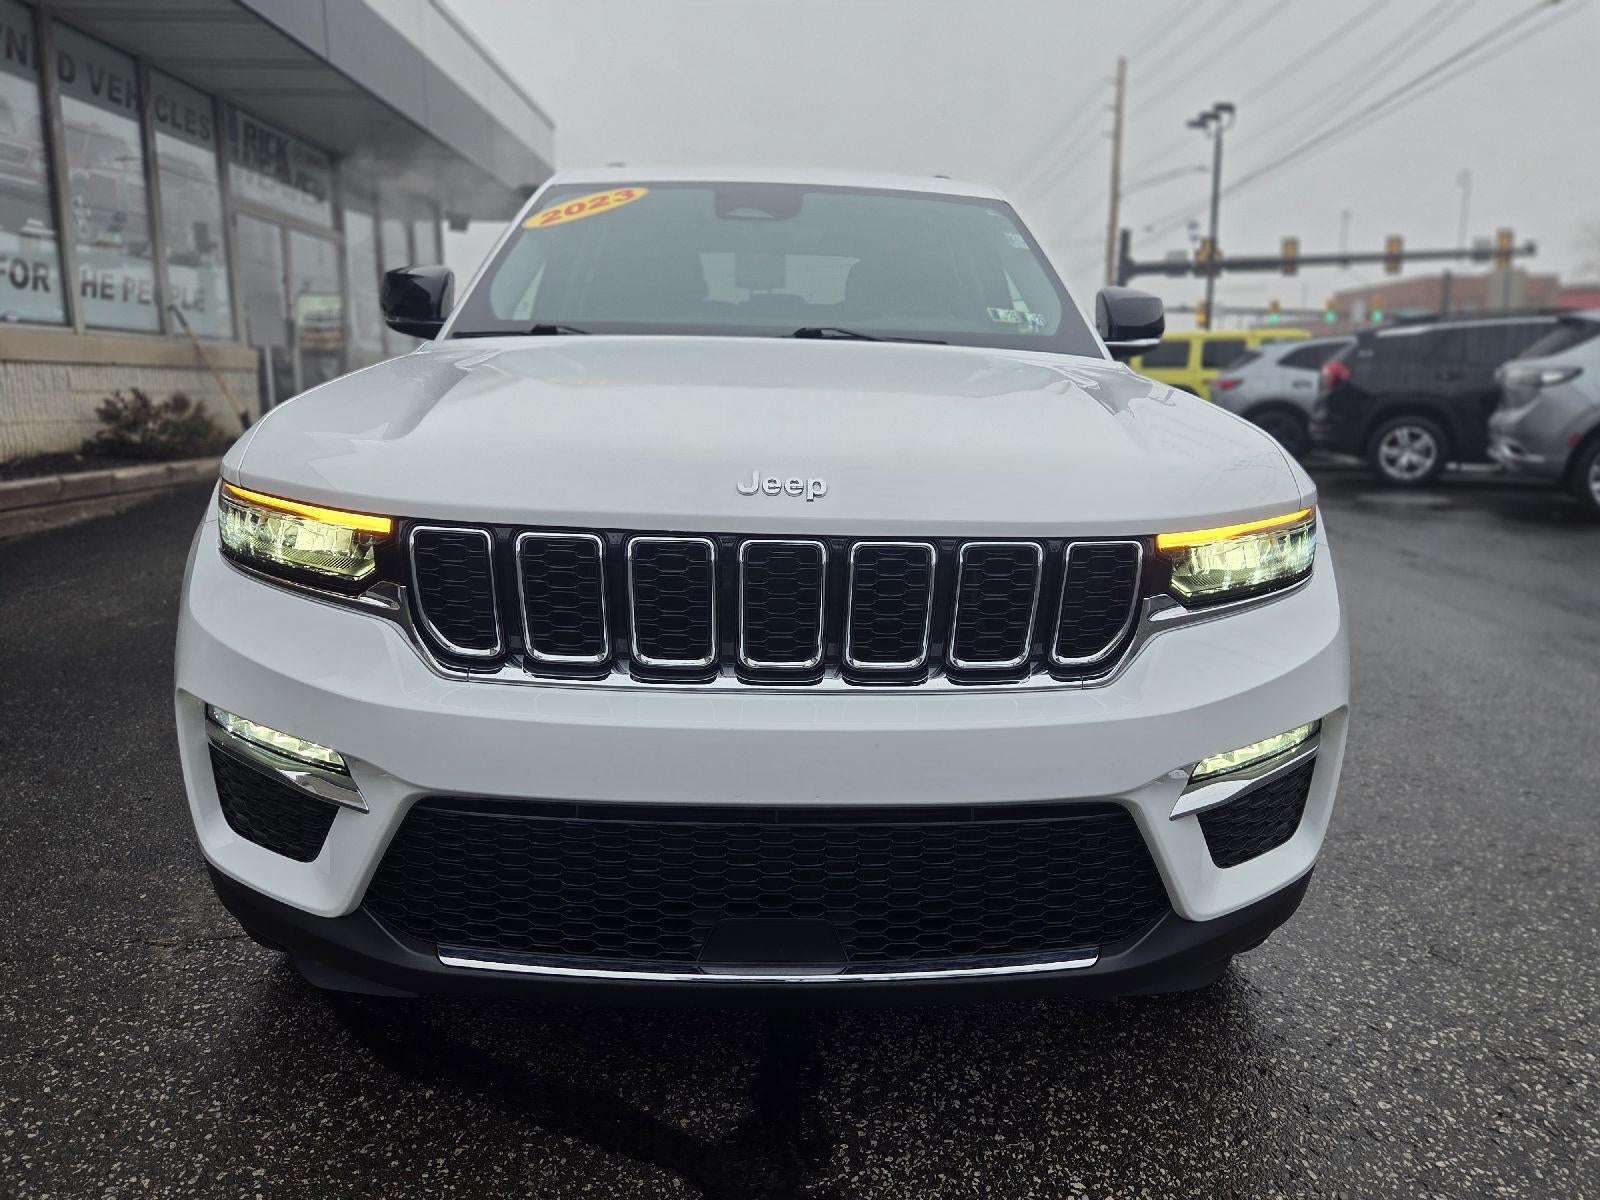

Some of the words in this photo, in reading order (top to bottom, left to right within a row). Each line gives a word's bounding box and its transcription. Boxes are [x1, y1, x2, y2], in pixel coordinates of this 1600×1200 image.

[87, 63, 211, 141] VEHCLES
[539, 189, 634, 226] 2023
[736, 469, 829, 502] Jeep
